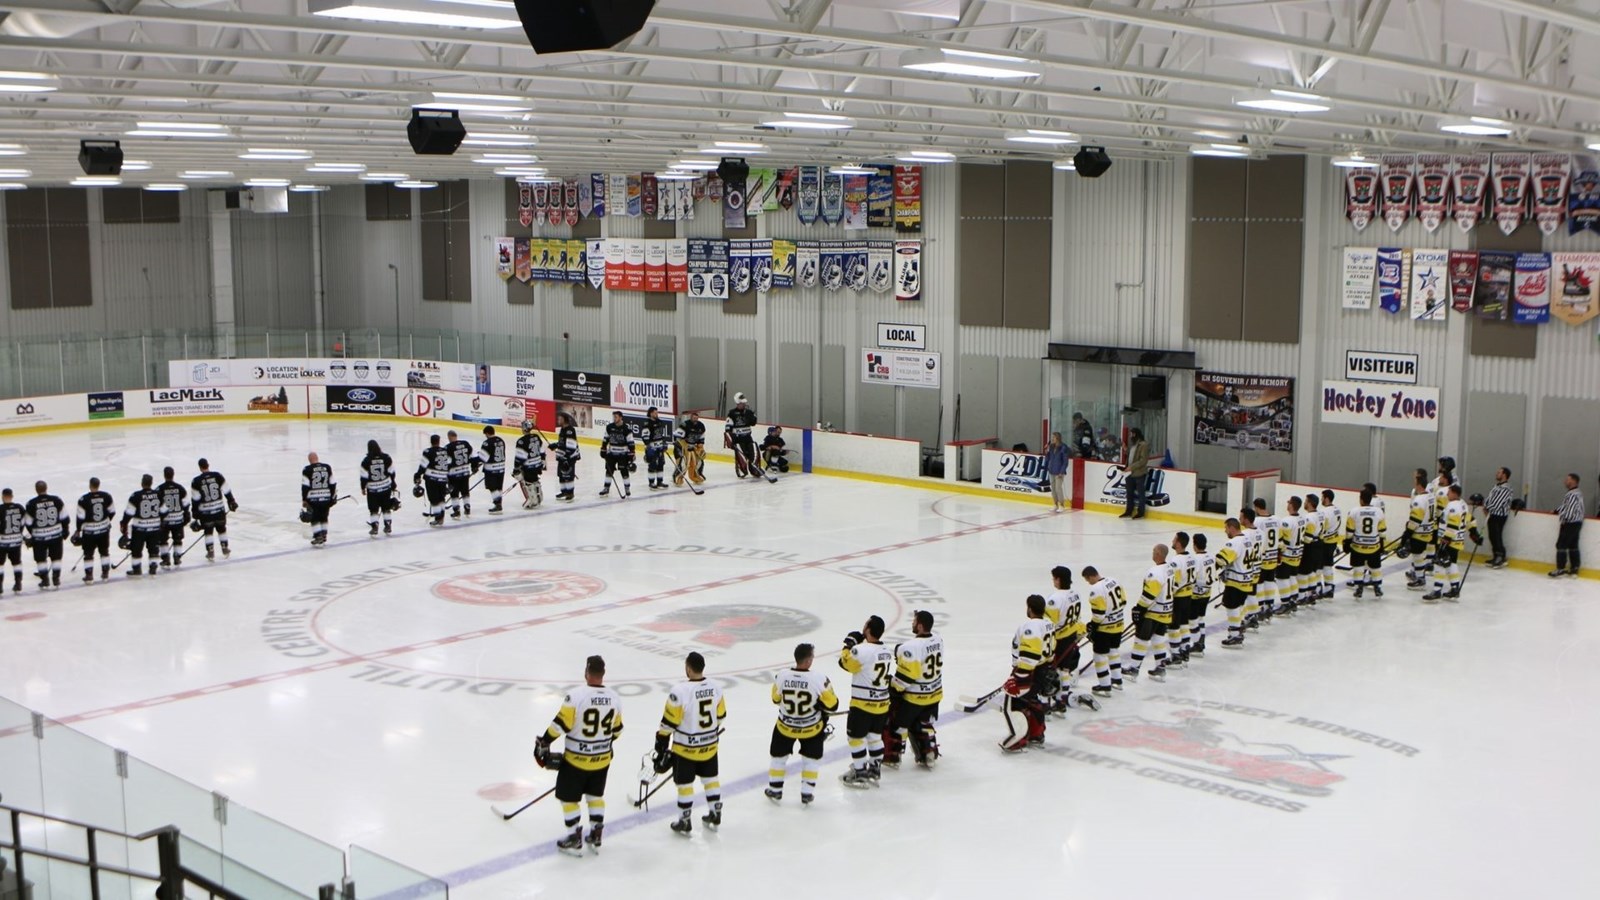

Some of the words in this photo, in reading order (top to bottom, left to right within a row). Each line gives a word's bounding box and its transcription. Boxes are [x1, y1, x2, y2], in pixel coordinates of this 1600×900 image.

[897, 208, 920, 217] CHAMPIONS
[886, 328, 917, 342] LOCAL
[516, 369, 535, 377] BEACH
[1349, 357, 1415, 375] VISITEUR
[1201, 374, 1211, 382] EN
[1212, 375, 1245, 385] SOUVENIR
[1259, 379, 1289, 387] MEMORY
[150, 388, 225, 403] LacMark
[351, 391, 371, 400] Ford
[629, 381, 669, 399] COUTURE
[330, 402, 392, 412] ST-GEORGES
[629, 396, 669, 408] ALUMINIUM
[1323, 387, 1386, 419] Hockey
[1391, 390, 1437, 420] Zone
[312, 471, 328, 489] 27
[994, 484, 1032, 493] ST-GEORGES
[201, 483, 219, 501] 16
[36, 506, 58, 528] 99
[92, 503, 104, 522] 9
[5, 514, 22, 534] 15
[1361, 516, 1373, 534] 8
[1267, 528, 1276, 548] 9
[289, 559, 431, 603] SPORTIF
[839, 564, 947, 605] CENTRE
[262, 607, 330, 659] CENTRE
[784, 679, 809, 689] CLOUTIER
[590, 697, 612, 706] HEBERT
[782, 689, 813, 716] 52
[582, 707, 616, 738] 94
[698, 698, 713, 729] 5
[1286, 715, 1422, 758] MINEUR
[1042, 743, 1311, 814] AINT-GEORGES
